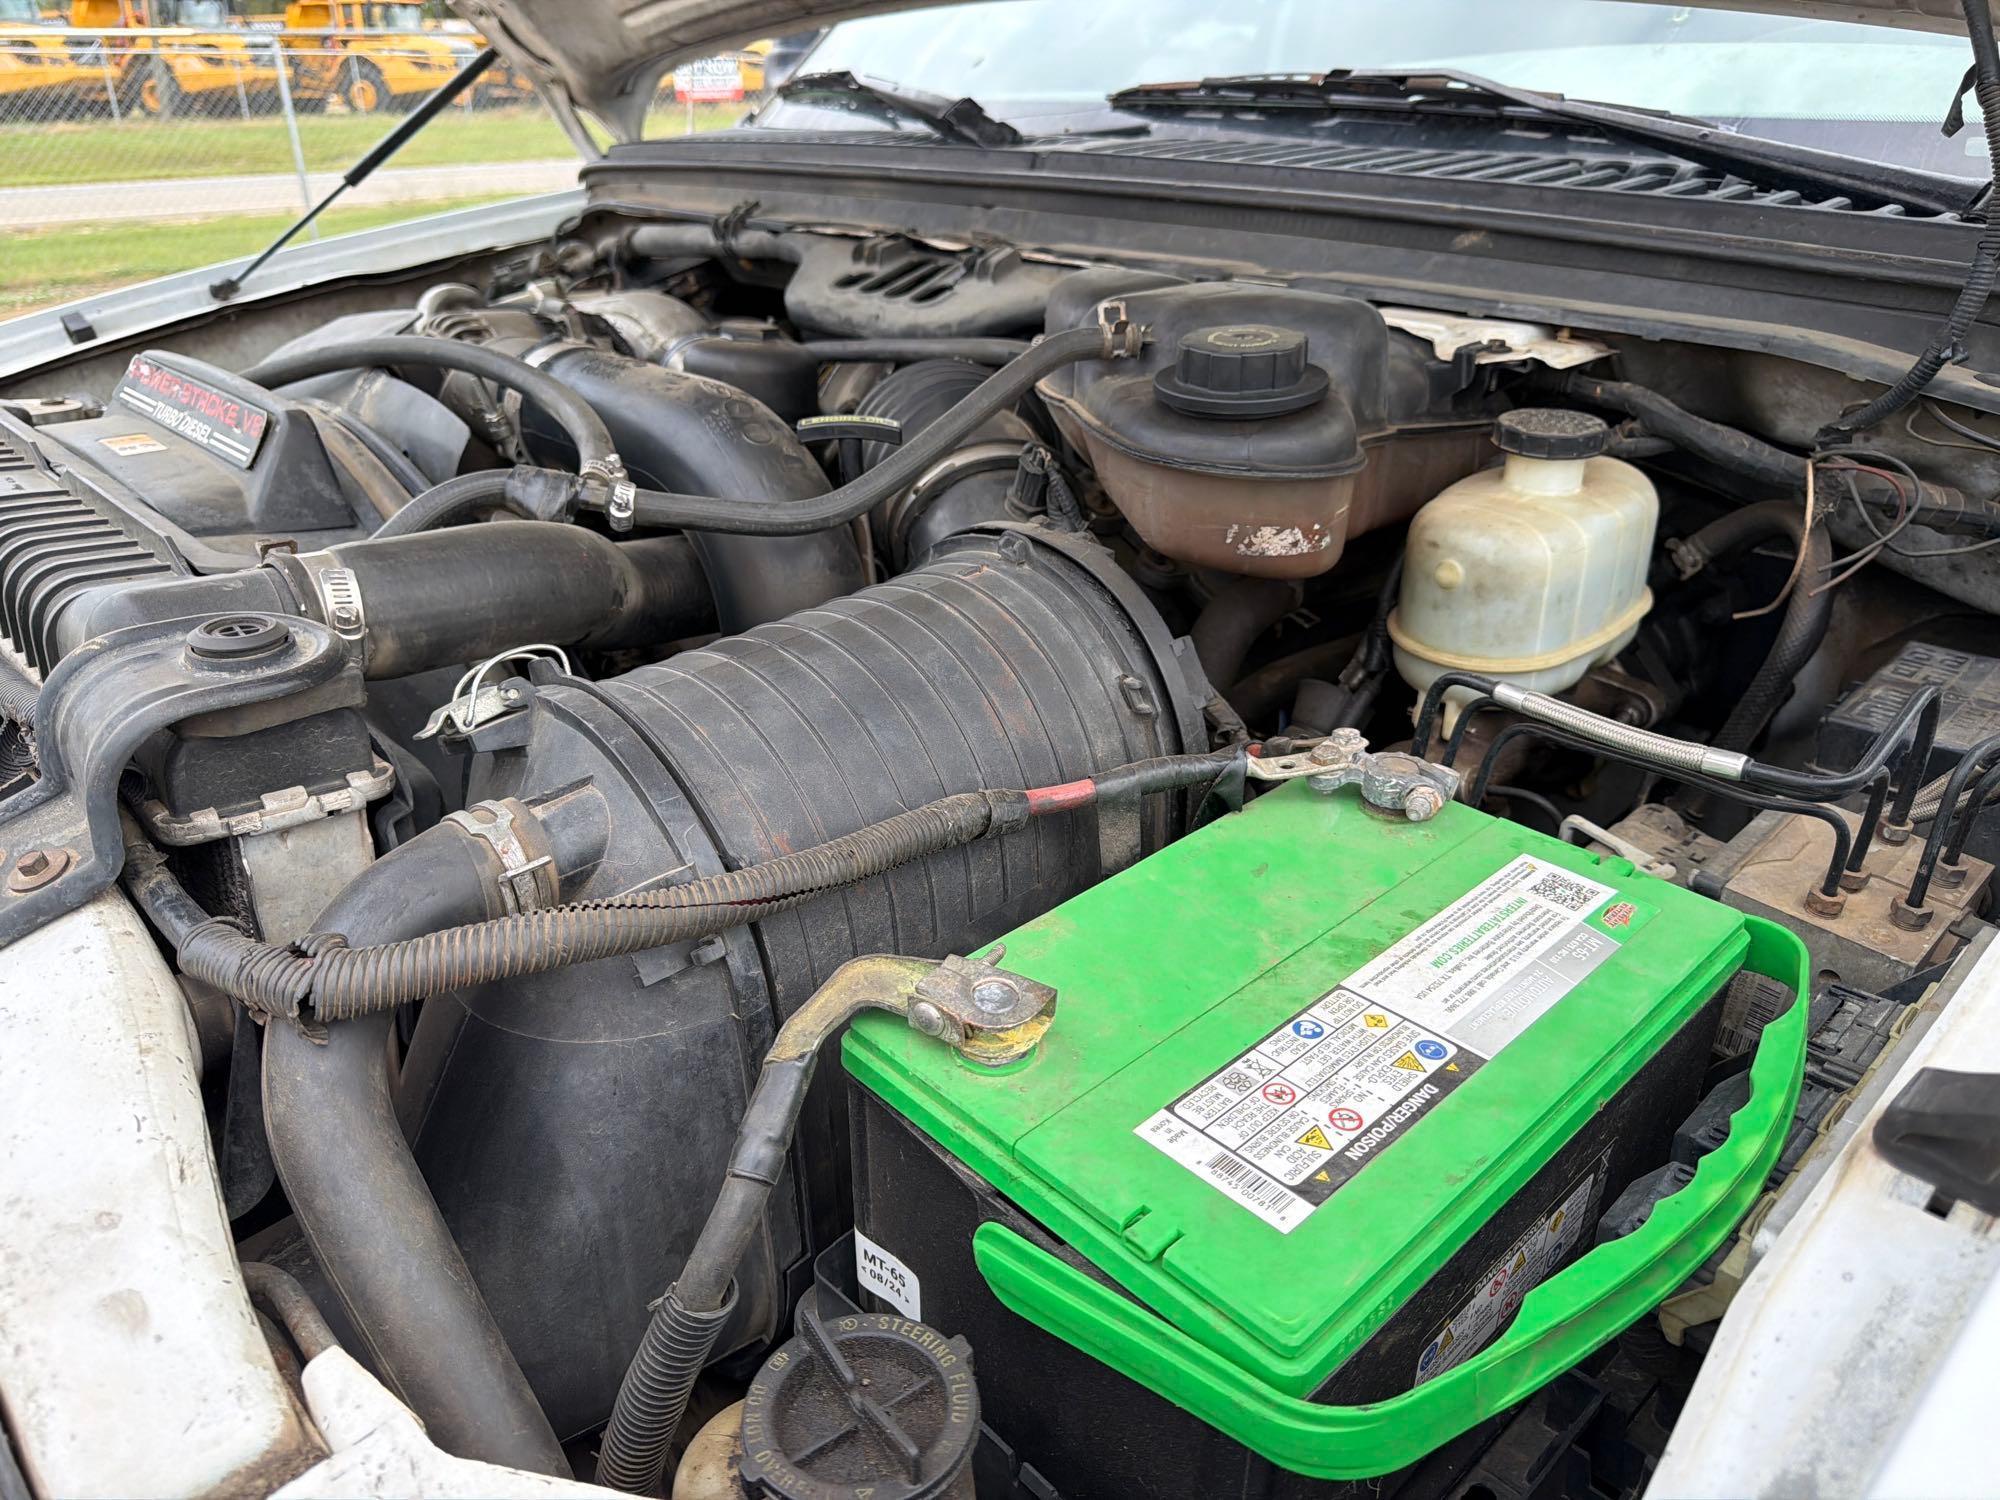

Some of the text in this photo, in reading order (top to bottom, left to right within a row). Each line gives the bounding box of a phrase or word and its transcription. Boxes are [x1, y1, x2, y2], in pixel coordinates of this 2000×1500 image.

[152, 400, 183, 428] TURBO
[180, 417, 213, 445] DIESEL
[1427, 895, 1529, 969] INTERSTATEBATTERIES.COM
[1569, 936, 1604, 961] MT-65
[1327, 995, 1355, 1015] OR OPEN
[1499, 974, 1557, 1018] AUTOMOTIVE
[1330, 1000, 1365, 1025] DO NOT TIP
[1328, 1021, 1359, 1043] MEDICAL
[1348, 1026, 1368, 1040] WITH
[1288, 1040, 1310, 1055] READ
[1302, 1031, 1378, 1088] FLUSH EYES IMMEDIATELY
[1313, 1040, 1334, 1055] HELP
[1314, 1053, 1333, 1066] GET
[1351, 1028, 1421, 1082] SIVE GASES CAN CAUSE
[1305, 1078, 1337, 1102] SMOKING
[1389, 1070, 1419, 1092] SHIELD
[1190, 1091, 1224, 1115] MUST BE
[1317, 1083, 1347, 1105] FLAMES
[1327, 1088, 1355, 1109] SPARKS
[1351, 1090, 1368, 1103] NO
[1199, 1096, 1233, 1121] BATTERY
[1230, 1100, 1271, 1131] THE REACH
[1258, 1106, 1280, 1122] KEEP
[1149, 1117, 1172, 1133] Korea
[1244, 1118, 1264, 1133] OUT
[1263, 1116, 1291, 1138] SEVERE
[1342, 1082, 1440, 1162] DANGER/POISON
[1165, 1128, 1189, 1145] Made
[1251, 1115, 1310, 1161] CAUSE BLINDNESS
[1272, 1143, 1292, 1158] CAN
[1284, 1146, 1308, 1164] ACID
[1282, 1149, 1323, 1181] SULFURIC
[1210, 1169, 1240, 1190] 88745
[1241, 1189, 1272, 1211] 00781
[863, 1248, 906, 1288] MT-65
[869, 1269, 902, 1297] 08/24
[878, 1315, 970, 1424] STEERING FLUID
